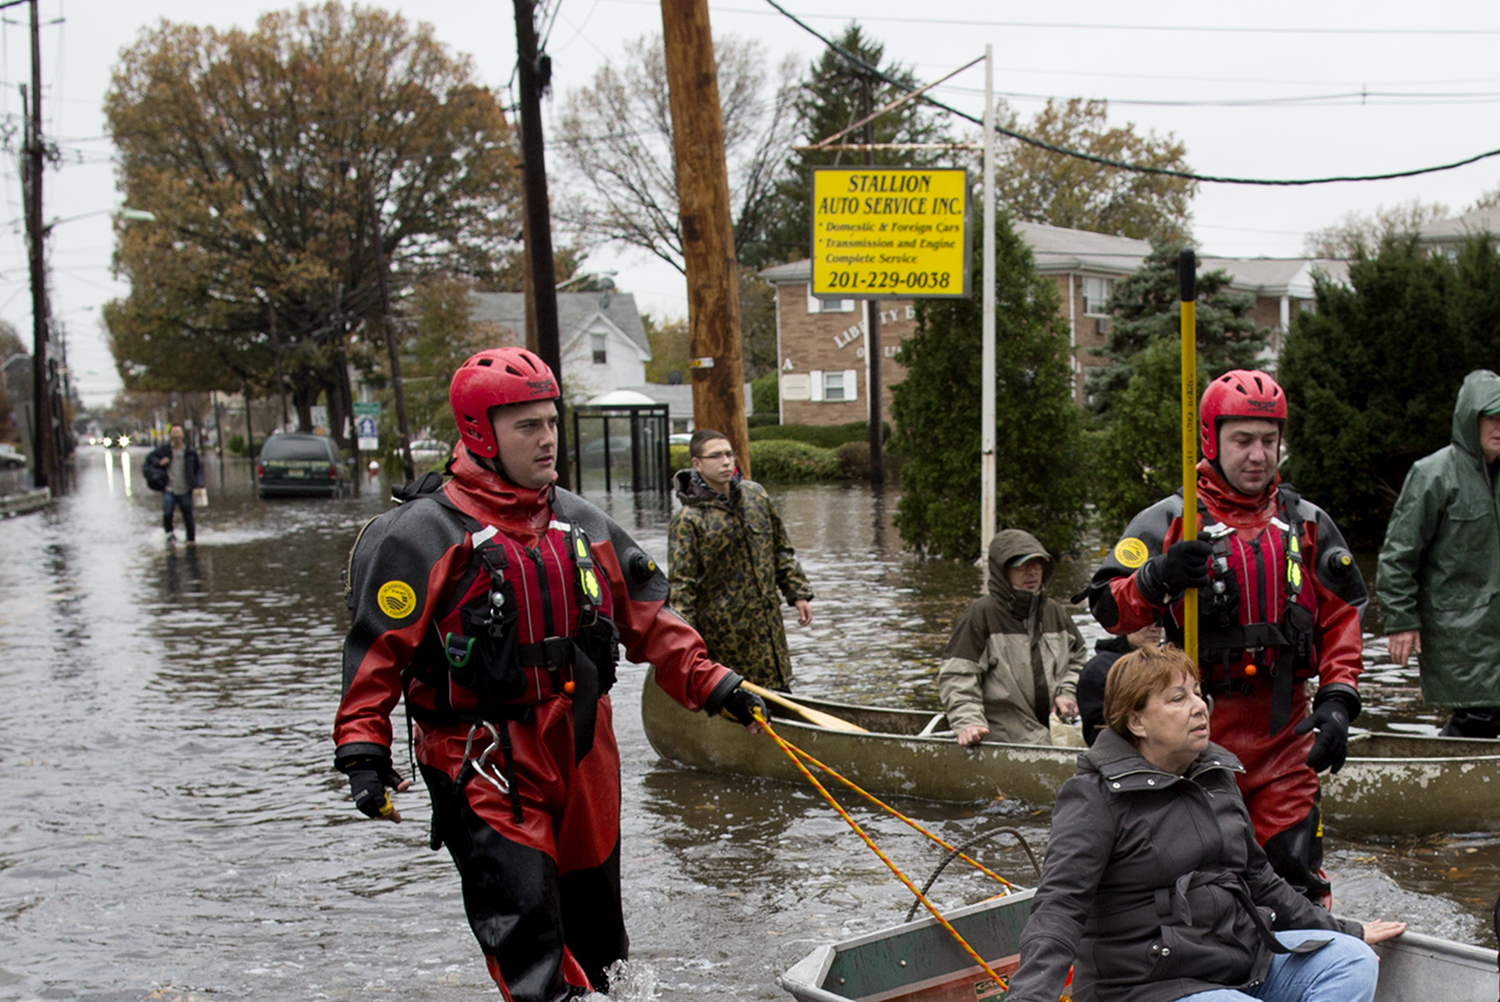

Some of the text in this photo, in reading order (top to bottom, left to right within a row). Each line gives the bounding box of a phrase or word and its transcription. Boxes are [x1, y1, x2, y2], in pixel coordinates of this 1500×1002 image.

[848, 175, 931, 192] STALLION
[818, 198, 962, 215] AUTO SERVICE INC.
[826, 222, 959, 234] Domestic & Foreign Cars
[826, 239, 955, 251] Transmission and Engine
[826, 254, 917, 265] Complete Service
[828, 271, 950, 288] 201-229-0038
